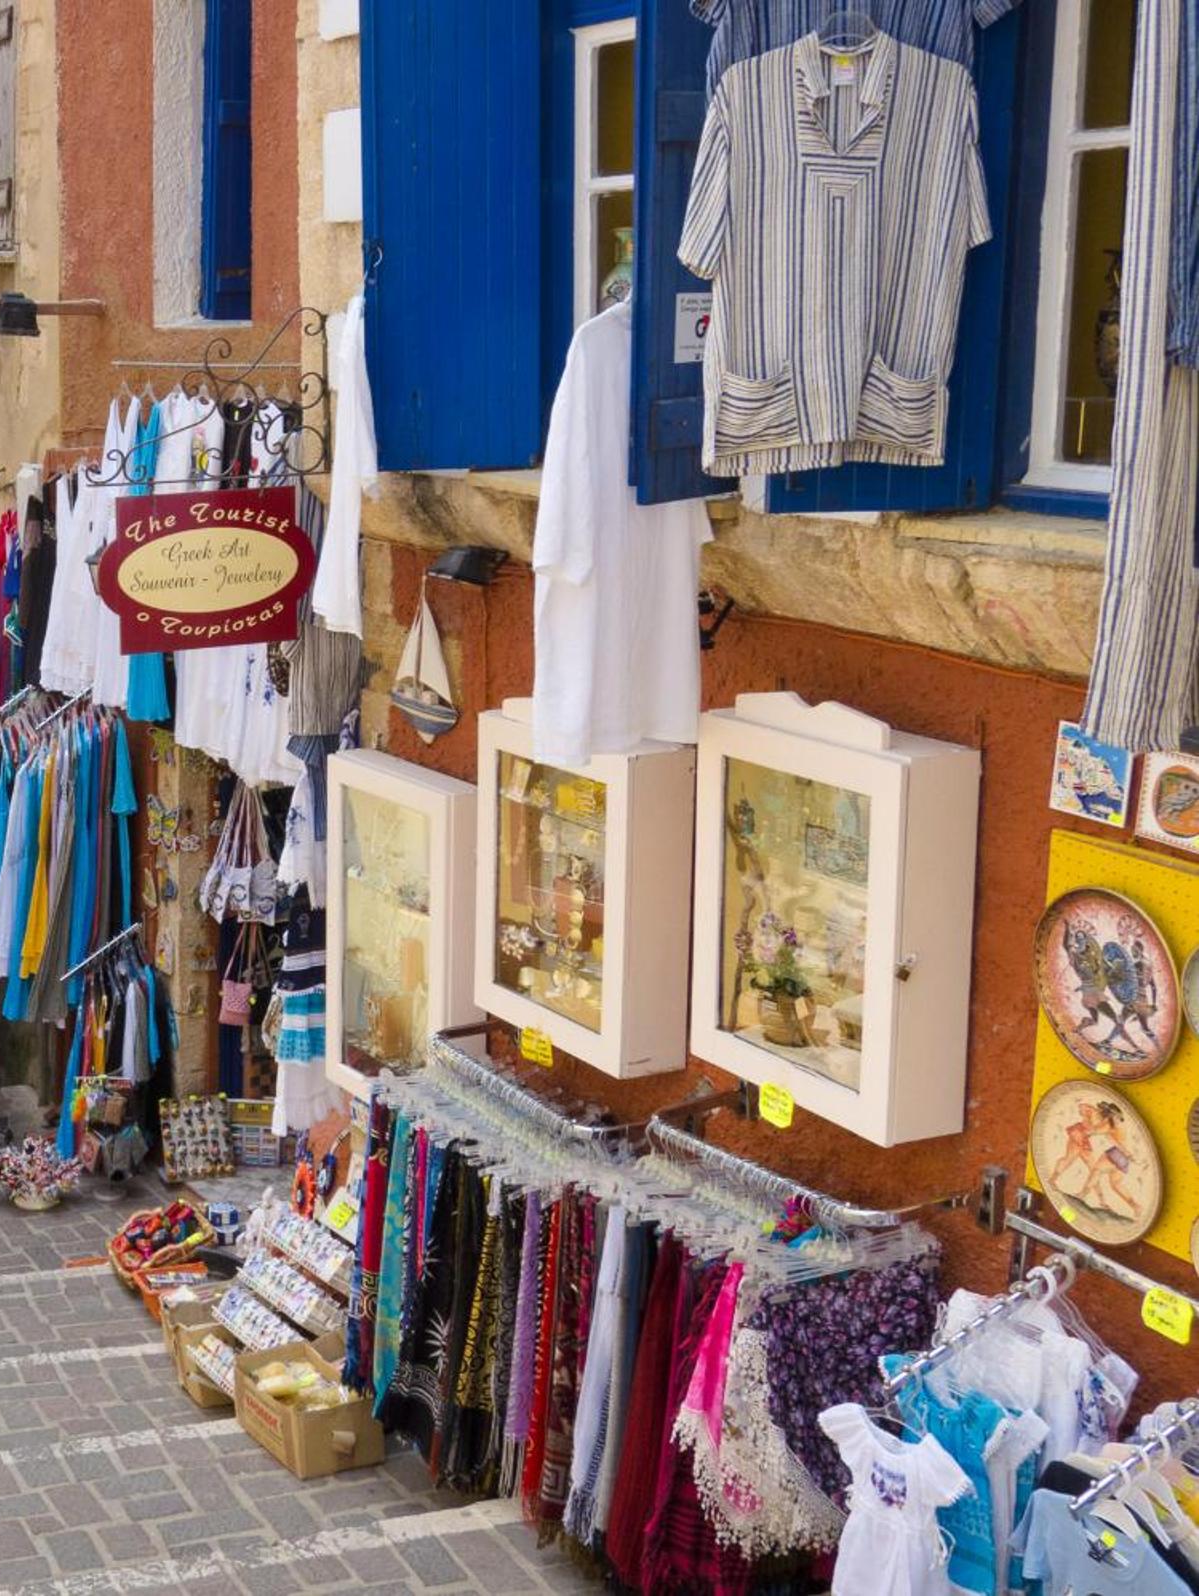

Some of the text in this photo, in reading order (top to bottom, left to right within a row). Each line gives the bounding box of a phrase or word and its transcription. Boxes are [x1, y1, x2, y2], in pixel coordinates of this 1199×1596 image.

[124, 502, 291, 542] The Tourist
[161, 538, 251, 570] Greek Art
[129, 569, 196, 593] Souvenir
[213, 562, 285, 593] Jewelery
